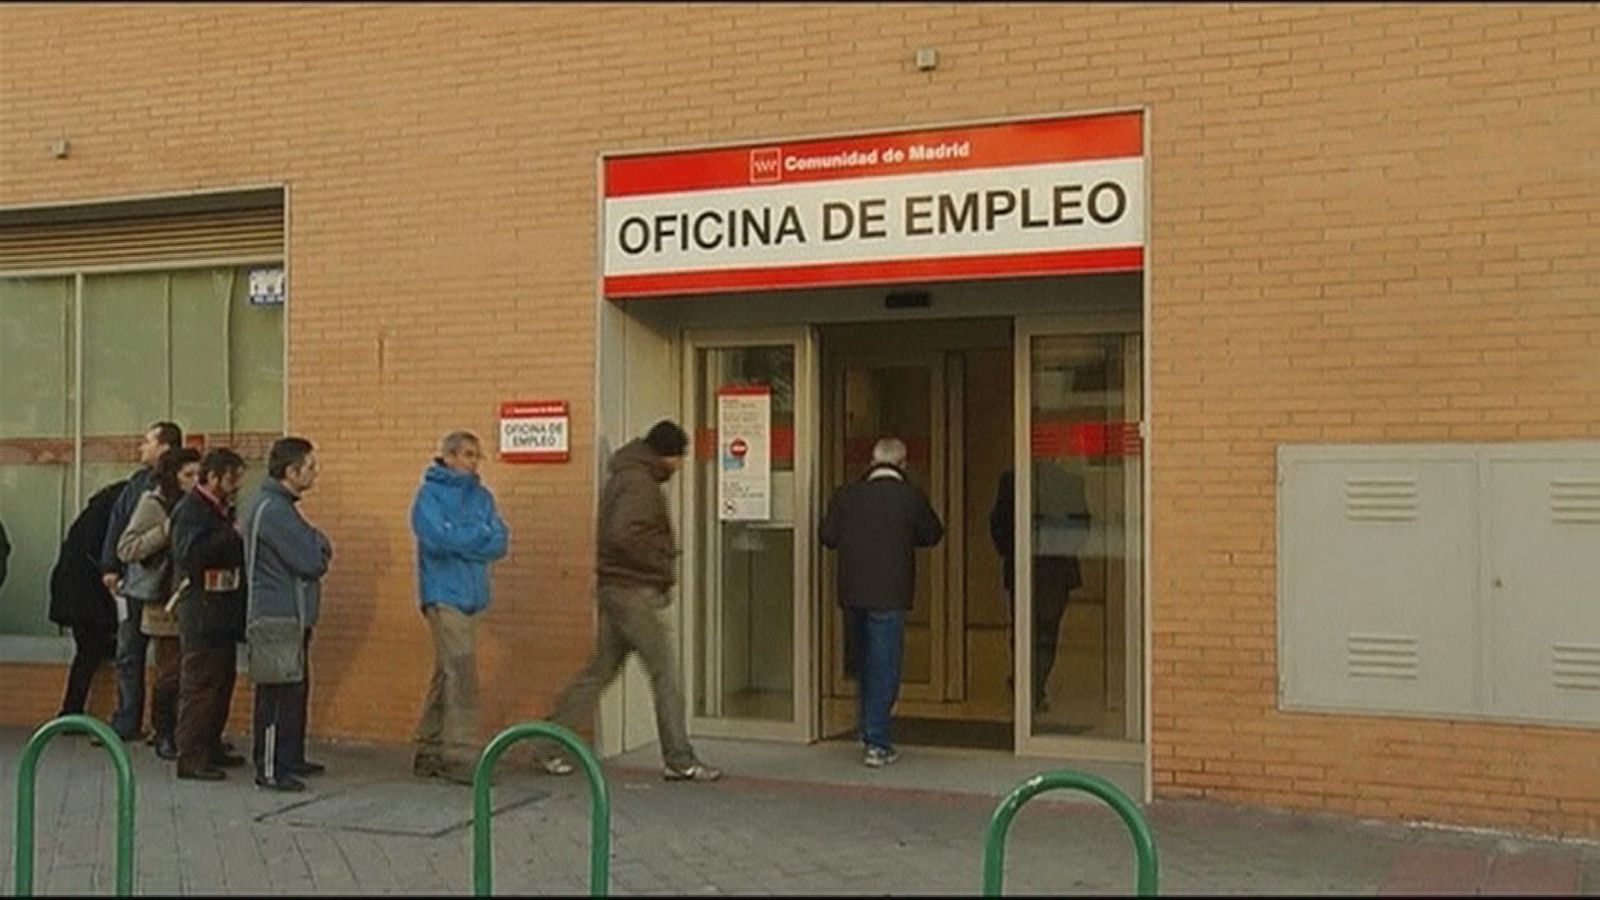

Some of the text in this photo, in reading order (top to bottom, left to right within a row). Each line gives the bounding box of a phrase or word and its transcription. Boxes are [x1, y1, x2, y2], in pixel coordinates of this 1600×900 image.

[784, 141, 970, 172] Comunidad de Madrid
[618, 181, 1127, 255] OFICINA DE EMPLEO
